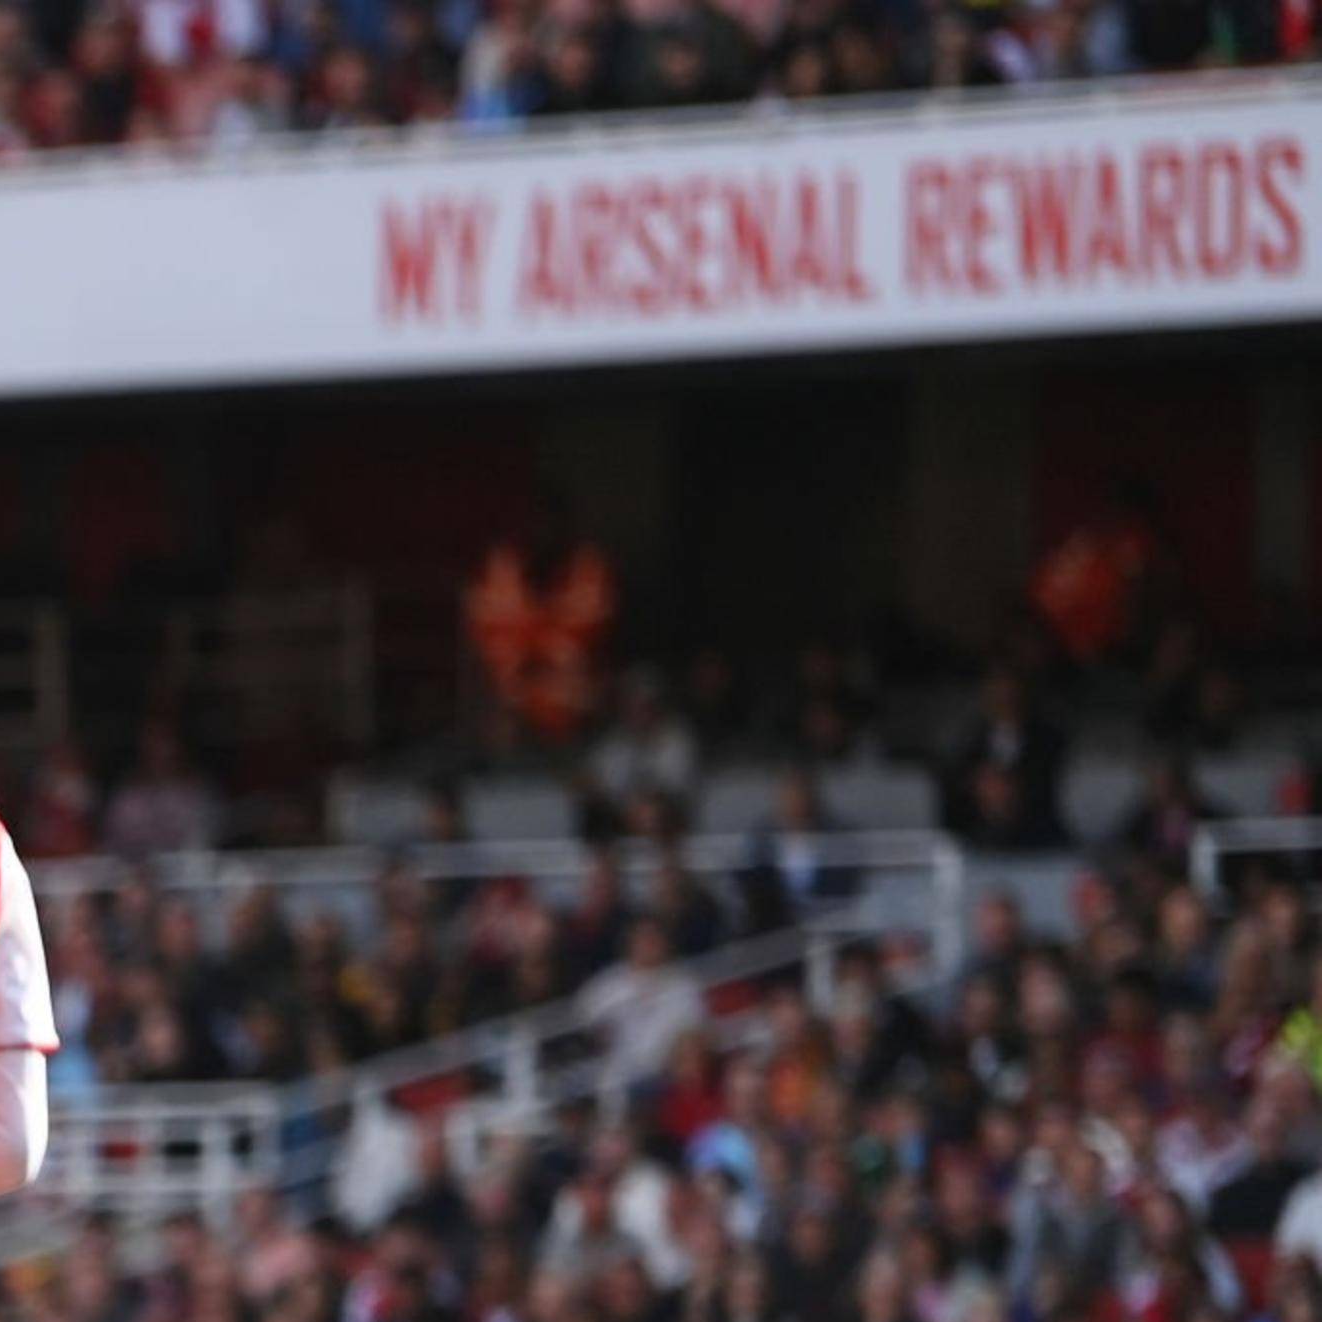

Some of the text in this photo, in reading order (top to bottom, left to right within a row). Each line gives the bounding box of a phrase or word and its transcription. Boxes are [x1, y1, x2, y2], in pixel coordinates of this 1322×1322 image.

[378, 134, 1307, 323] MY ARSENAL REWARDS
